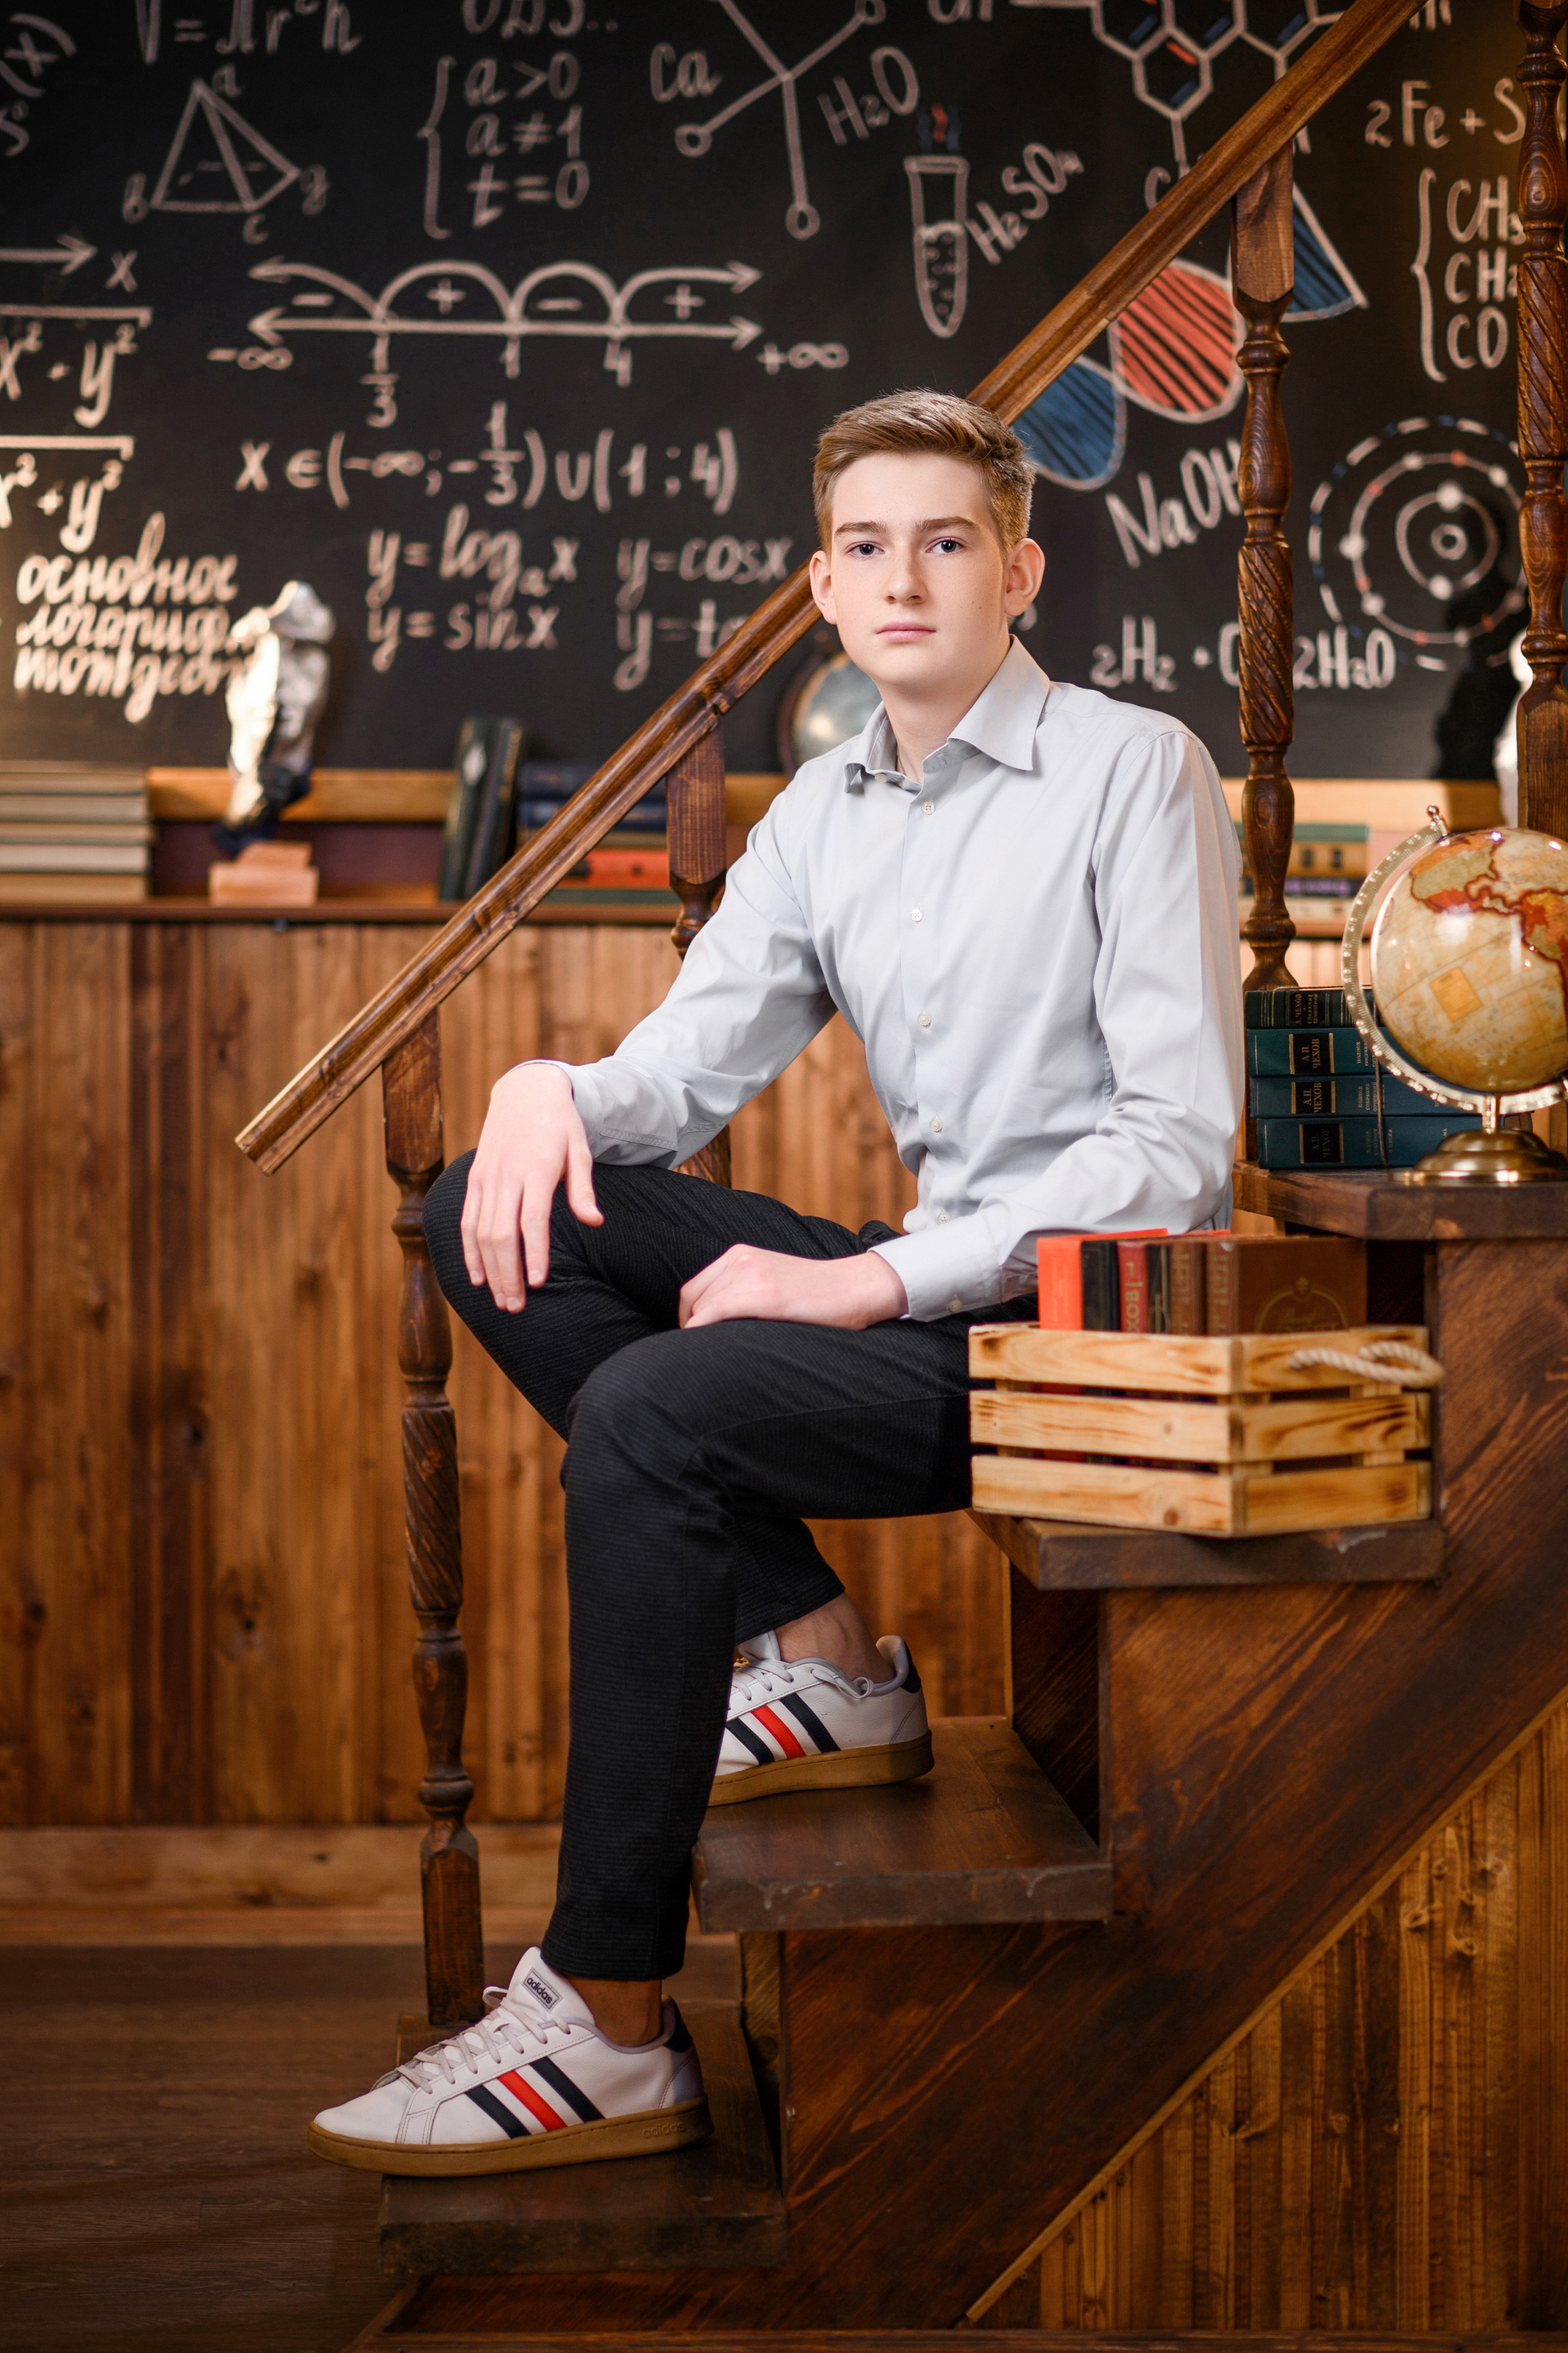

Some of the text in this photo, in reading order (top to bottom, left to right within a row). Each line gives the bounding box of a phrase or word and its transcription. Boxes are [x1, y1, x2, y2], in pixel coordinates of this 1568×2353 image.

[1311, 1038, 1321, 1069] ЧЕХОВ
[1313, 1082, 1322, 1113] ЧЕХОВ
[527, 1978, 552, 2004] adidas
[641, 2121, 685, 2139] adidas
